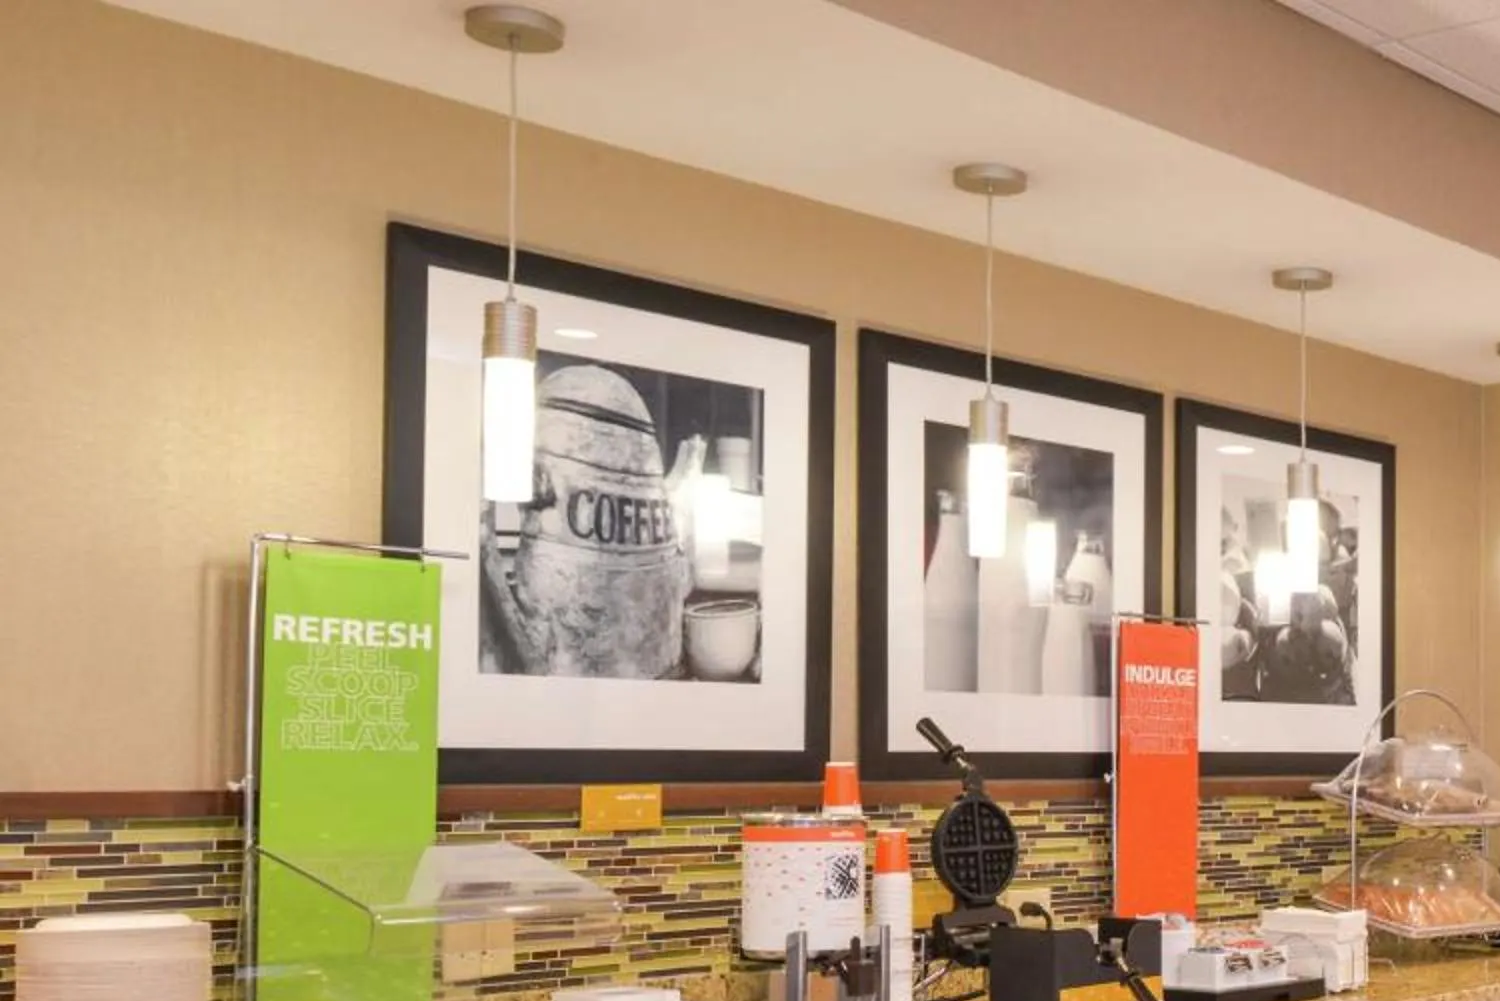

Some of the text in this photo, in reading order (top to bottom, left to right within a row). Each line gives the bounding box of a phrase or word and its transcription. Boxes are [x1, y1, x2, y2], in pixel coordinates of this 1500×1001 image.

[567, 489, 671, 545] COFFEE
[273, 613, 432, 651] REFRESH
[285, 665, 419, 699] SCOOP
[1125, 663, 1196, 687] INDULGE
[298, 696, 406, 724] SLICE
